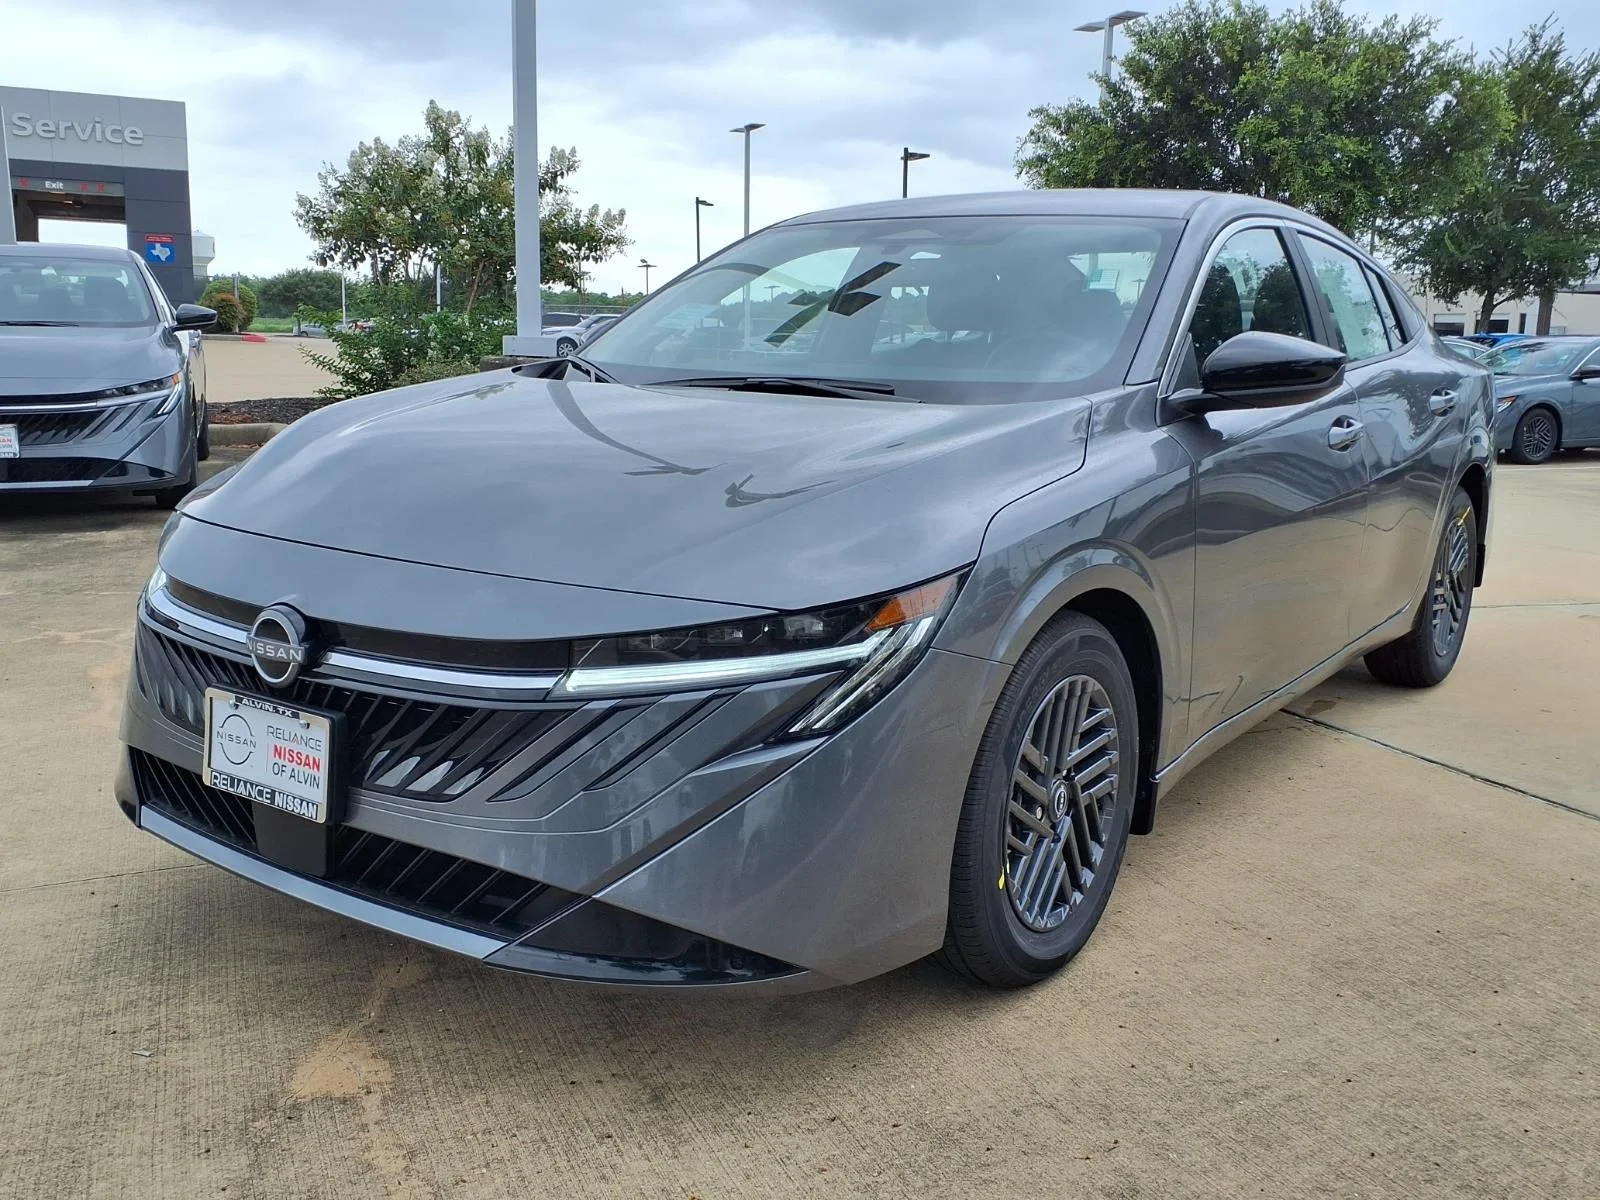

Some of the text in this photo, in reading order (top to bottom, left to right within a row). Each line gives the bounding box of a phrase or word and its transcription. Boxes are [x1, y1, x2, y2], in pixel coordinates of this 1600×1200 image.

[12, 112, 144, 145] Service
[45, 180, 64, 190] Exit
[246, 639, 302, 661] NISSAN
[278, 707, 293, 718] TX
[216, 730, 257, 749] NISSAN
[266, 725, 322, 752] RELIANCE
[273, 744, 321, 772] NISSAN
[272, 762, 320, 789] OF ALVIN
[211, 771, 317, 819] RELIANCE NISSAN
